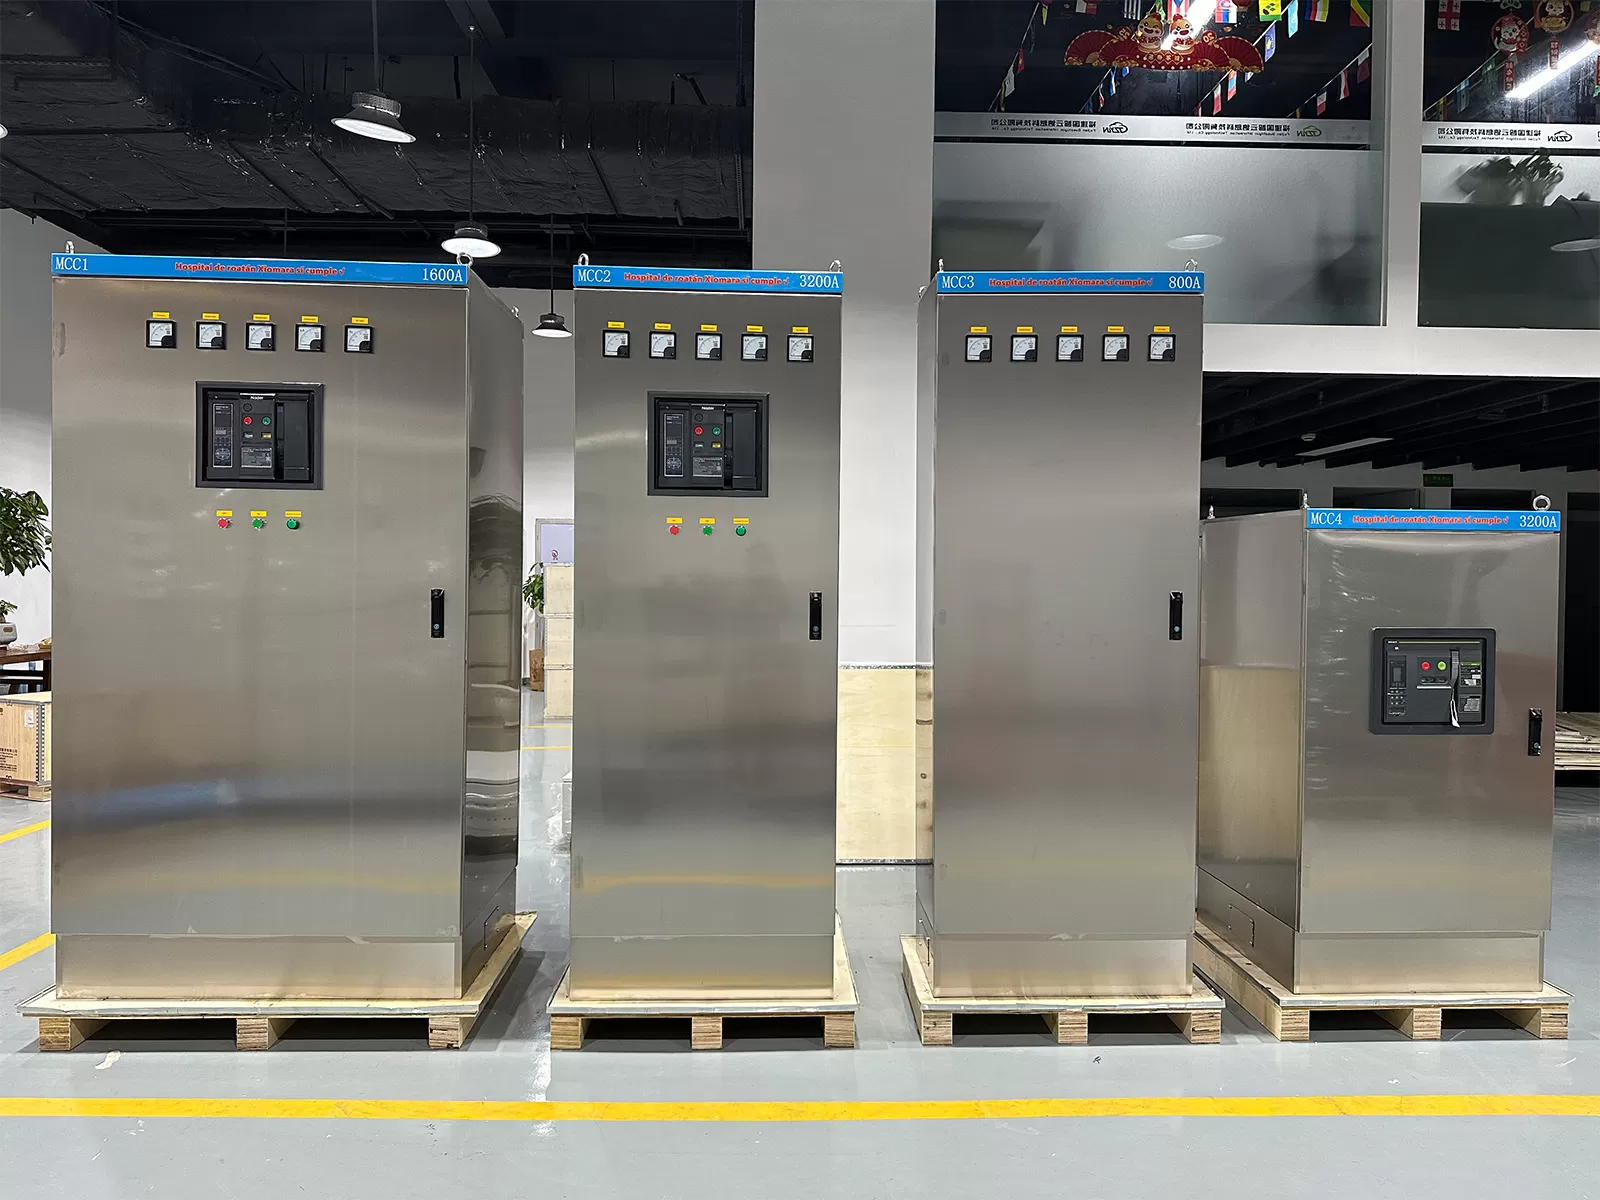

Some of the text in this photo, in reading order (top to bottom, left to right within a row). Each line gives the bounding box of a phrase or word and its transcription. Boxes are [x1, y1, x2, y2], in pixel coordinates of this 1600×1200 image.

[55, 256, 88, 271] MCC1
[175, 261, 213, 272] Hospital
[214, 262, 226, 271] de
[226, 263, 256, 273] roatán
[257, 264, 295, 274] Xiomara
[305, 265, 338, 277] cumple
[422, 267, 464, 282] 1600A
[577, 268, 611, 283] MCC2
[623, 271, 661, 283] Hospital
[662, 273, 674, 282] de
[703, 274, 740, 284] Xiomara
[750, 276, 782, 286] cumple
[799, 274, 840, 289] 3200A
[941, 275, 975, 289] MCC3
[988, 277, 1025, 288] Hospital
[1026, 277, 1037, 287] de
[1068, 277, 1104, 287] Xiomara
[1114, 277, 1146, 288] cumple
[1168, 275, 1201, 289] 800A
[1310, 511, 1343, 525] MCC4
[1353, 514, 1388, 525] Hospital
[1389, 514, 1399, 523] de
[1428, 515, 1462, 524] Xiomara
[1471, 515, 1502, 526] cumple
[1519, 514, 1557, 528] 3200A
